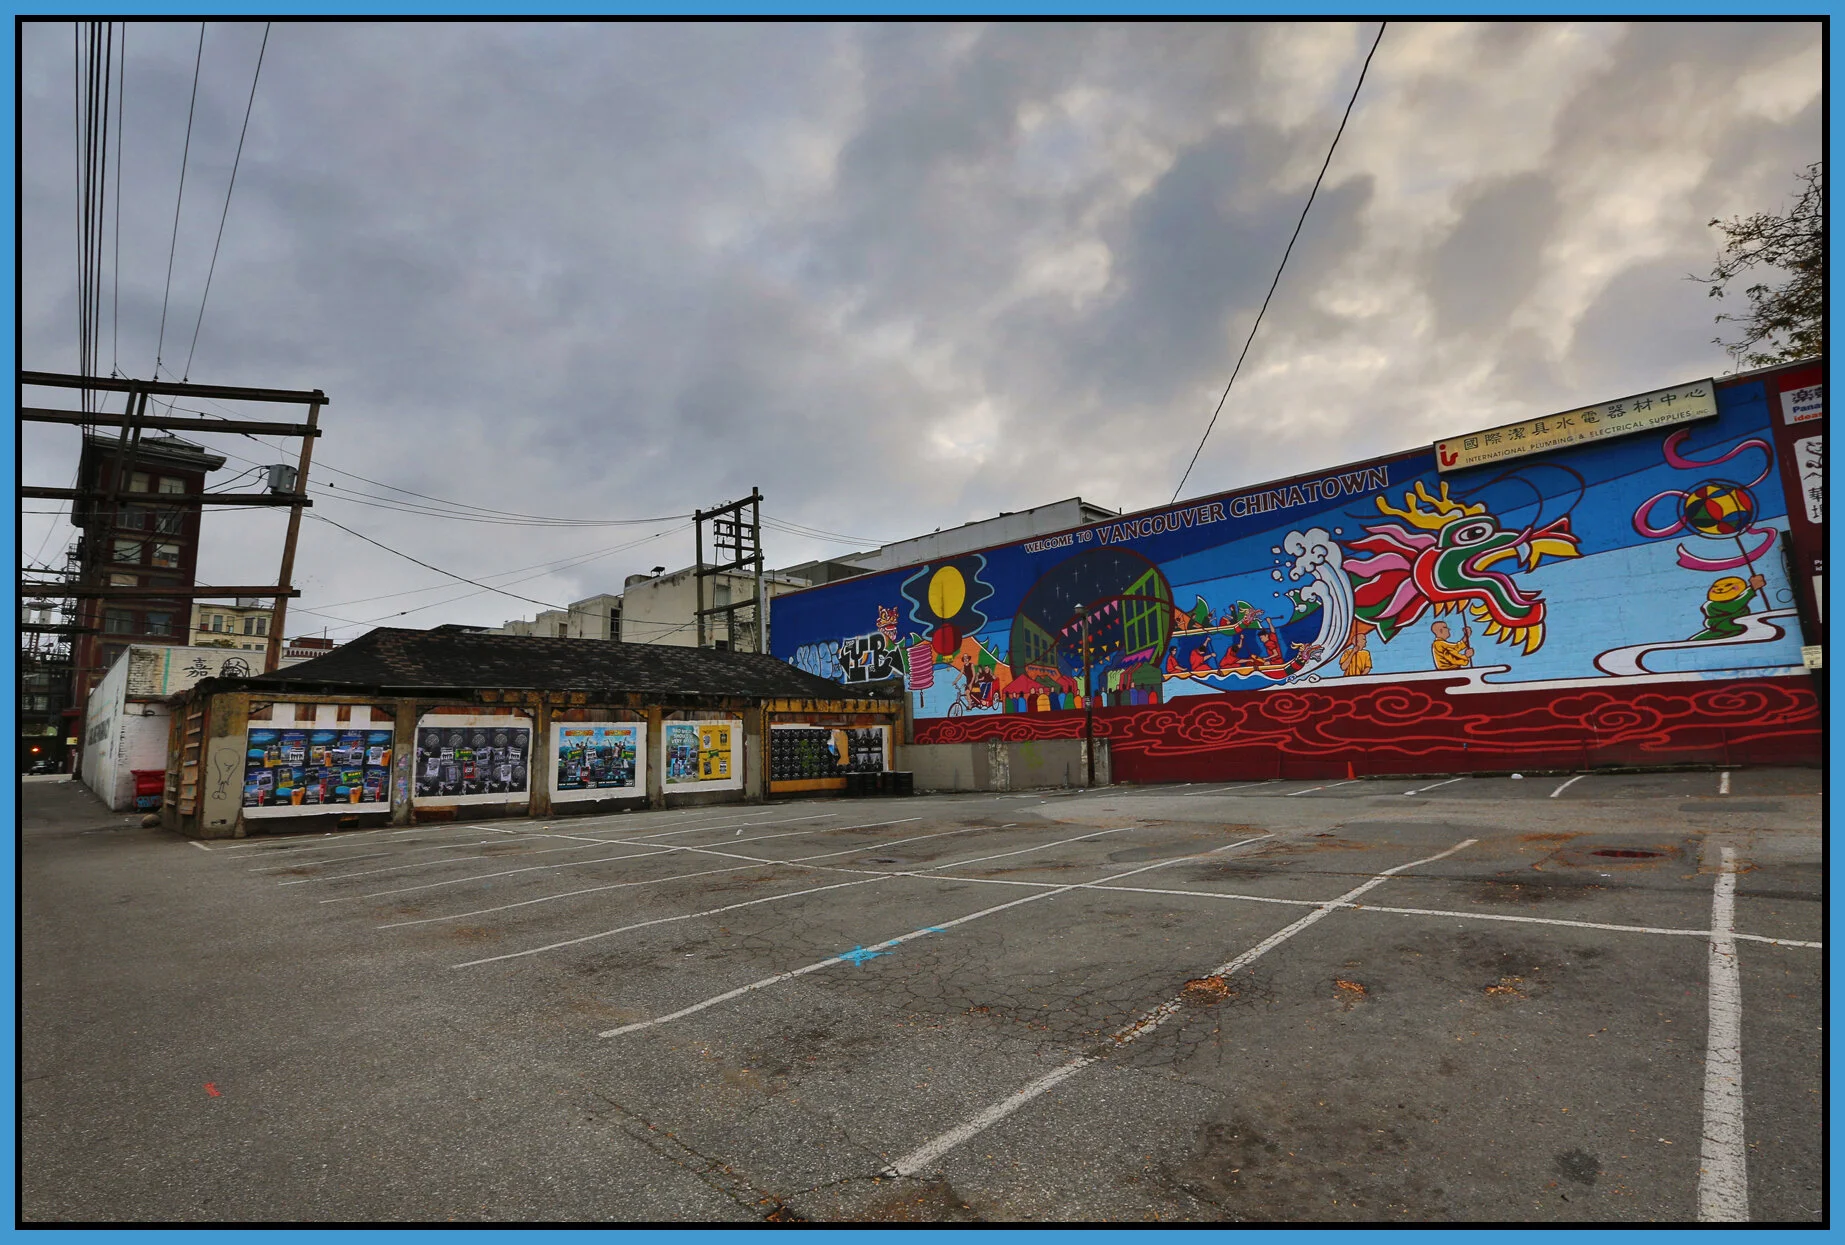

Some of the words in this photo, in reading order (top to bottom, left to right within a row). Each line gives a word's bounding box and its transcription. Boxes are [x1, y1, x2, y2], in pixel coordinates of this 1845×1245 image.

[1466, 446, 1526, 464] INTERNATIONAL
[1530, 435, 1573, 450] PLUMBING
[1589, 420, 1644, 438] ELECTRICAL
[1649, 410, 1691, 425] SUPPLIES
[1024, 533, 1073, 554] WELCOME
[1077, 530, 1093, 543] TO
[1096, 501, 1227, 546] VANCOUVER
[1229, 465, 1389, 518] CHINATOWN
